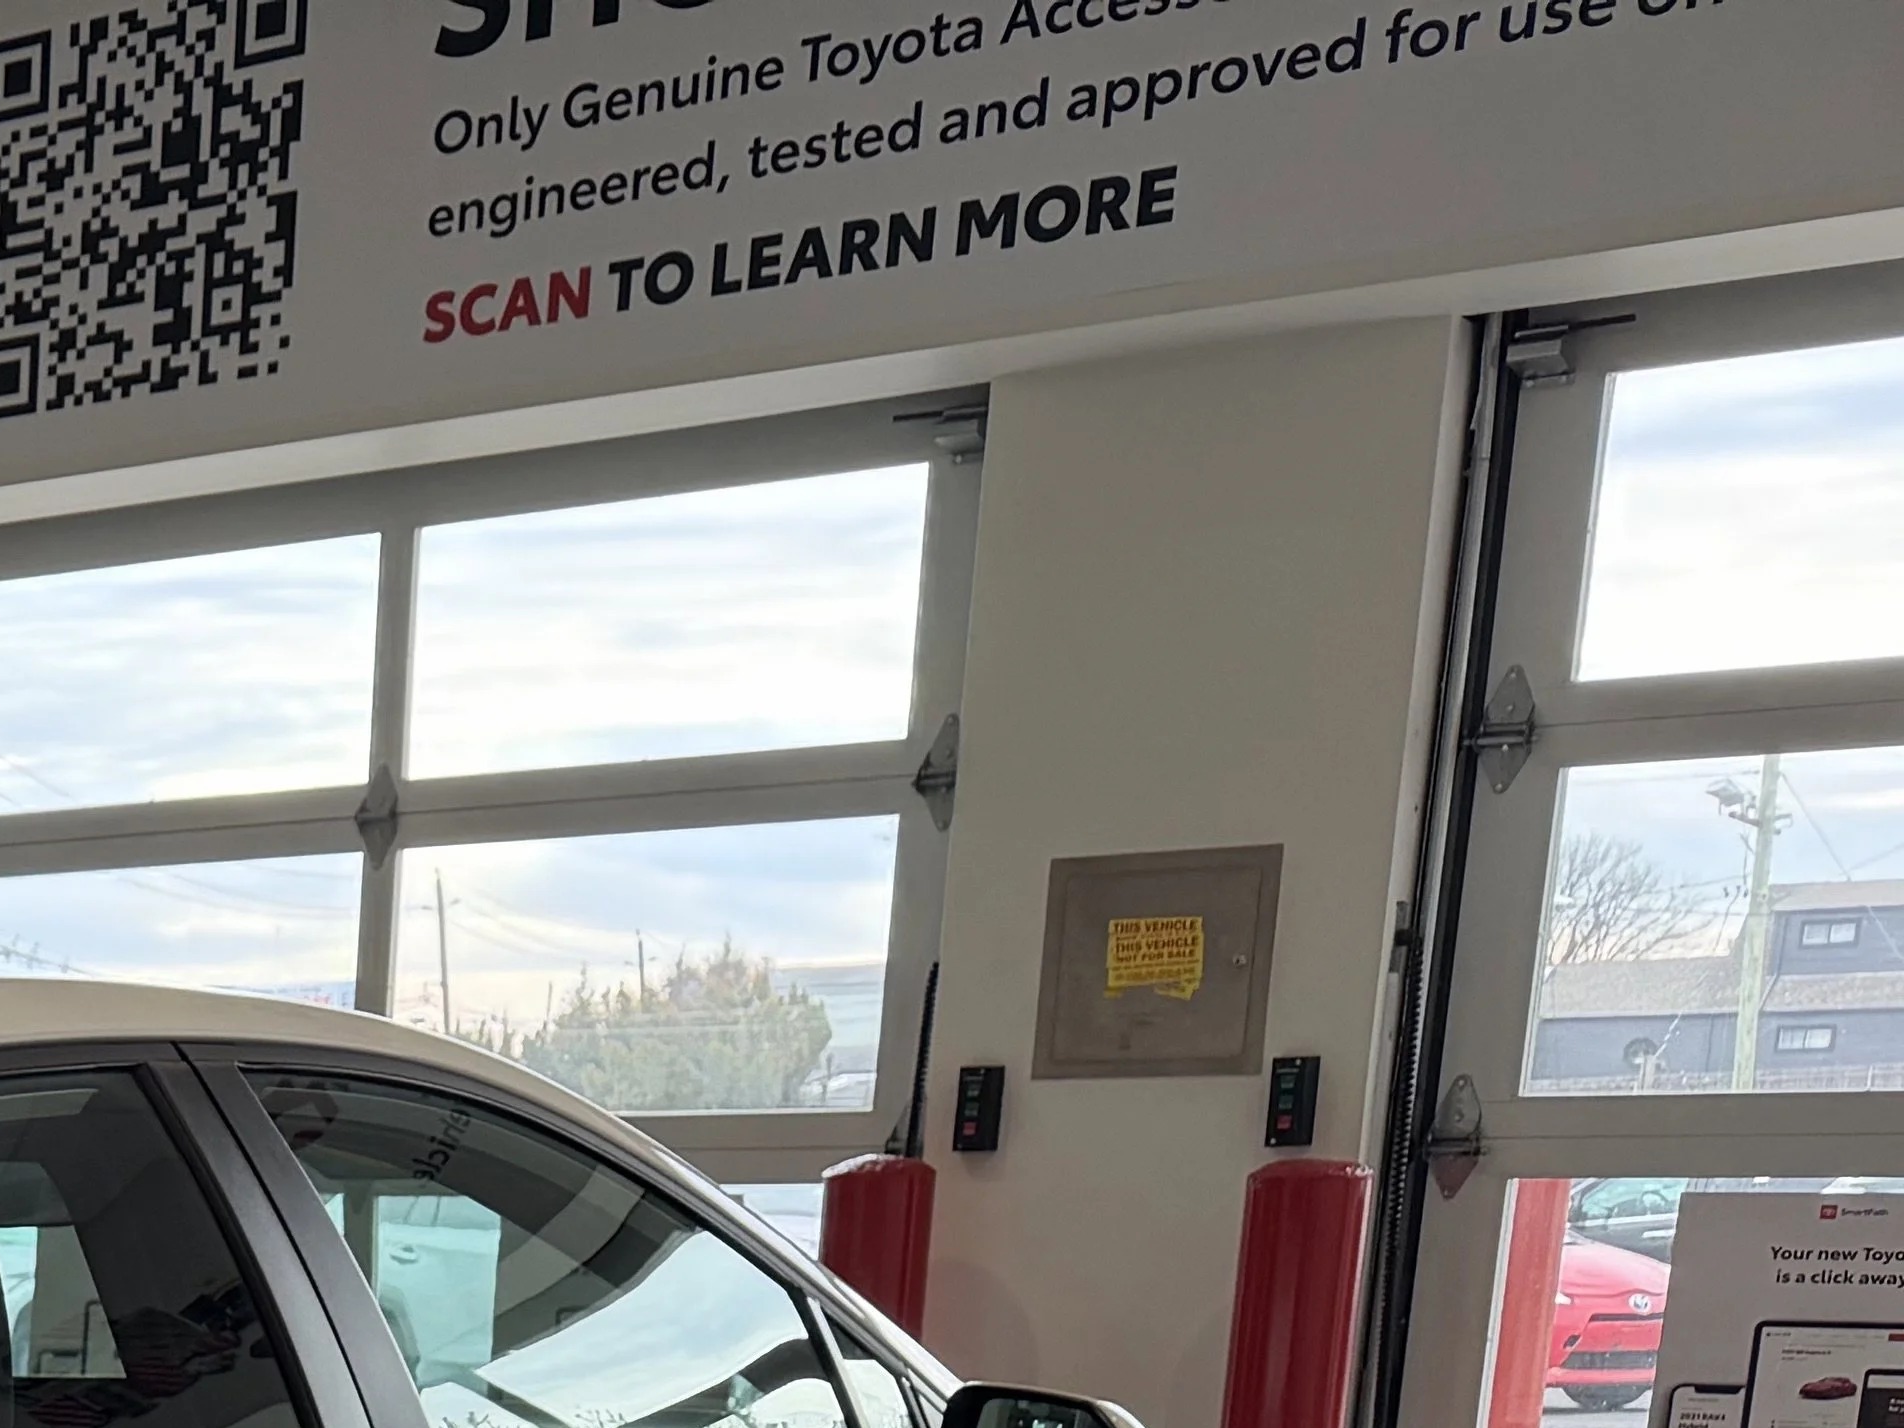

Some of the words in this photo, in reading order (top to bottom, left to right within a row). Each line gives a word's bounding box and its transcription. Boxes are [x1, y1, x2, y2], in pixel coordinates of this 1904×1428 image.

[434, 96, 549, 154] Only
[562, 55, 785, 129] Genuine
[800, 13, 984, 86] Toyota
[428, 139, 730, 239] engineered,
[748, 100, 923, 178] tested
[939, 76, 1050, 144] and
[1066, 17, 1366, 128] approved
[1385, 6, 1480, 64] for
[1499, 0, 1614, 42] use
[423, 266, 592, 344] SCAN
[608, 250, 695, 313] TO
[711, 206, 937, 298] LEARN
[955, 165, 1178, 257] MORE
[1114, 920, 1141, 934] THIS
[1145, 918, 1197, 932] VEHICLE
[1116, 940, 1142, 954] THIS
[1145, 935, 1199, 950] VEHICLE
[1771, 1245, 1813, 1260] Your
[1818, 1250, 1858, 1260] new
[1863, 1247, 1904, 1265] Toyo
[1776, 1268, 1791, 1283] is
[1795, 1273, 1806, 1283] a
[1811, 1269, 1854, 1284] click
